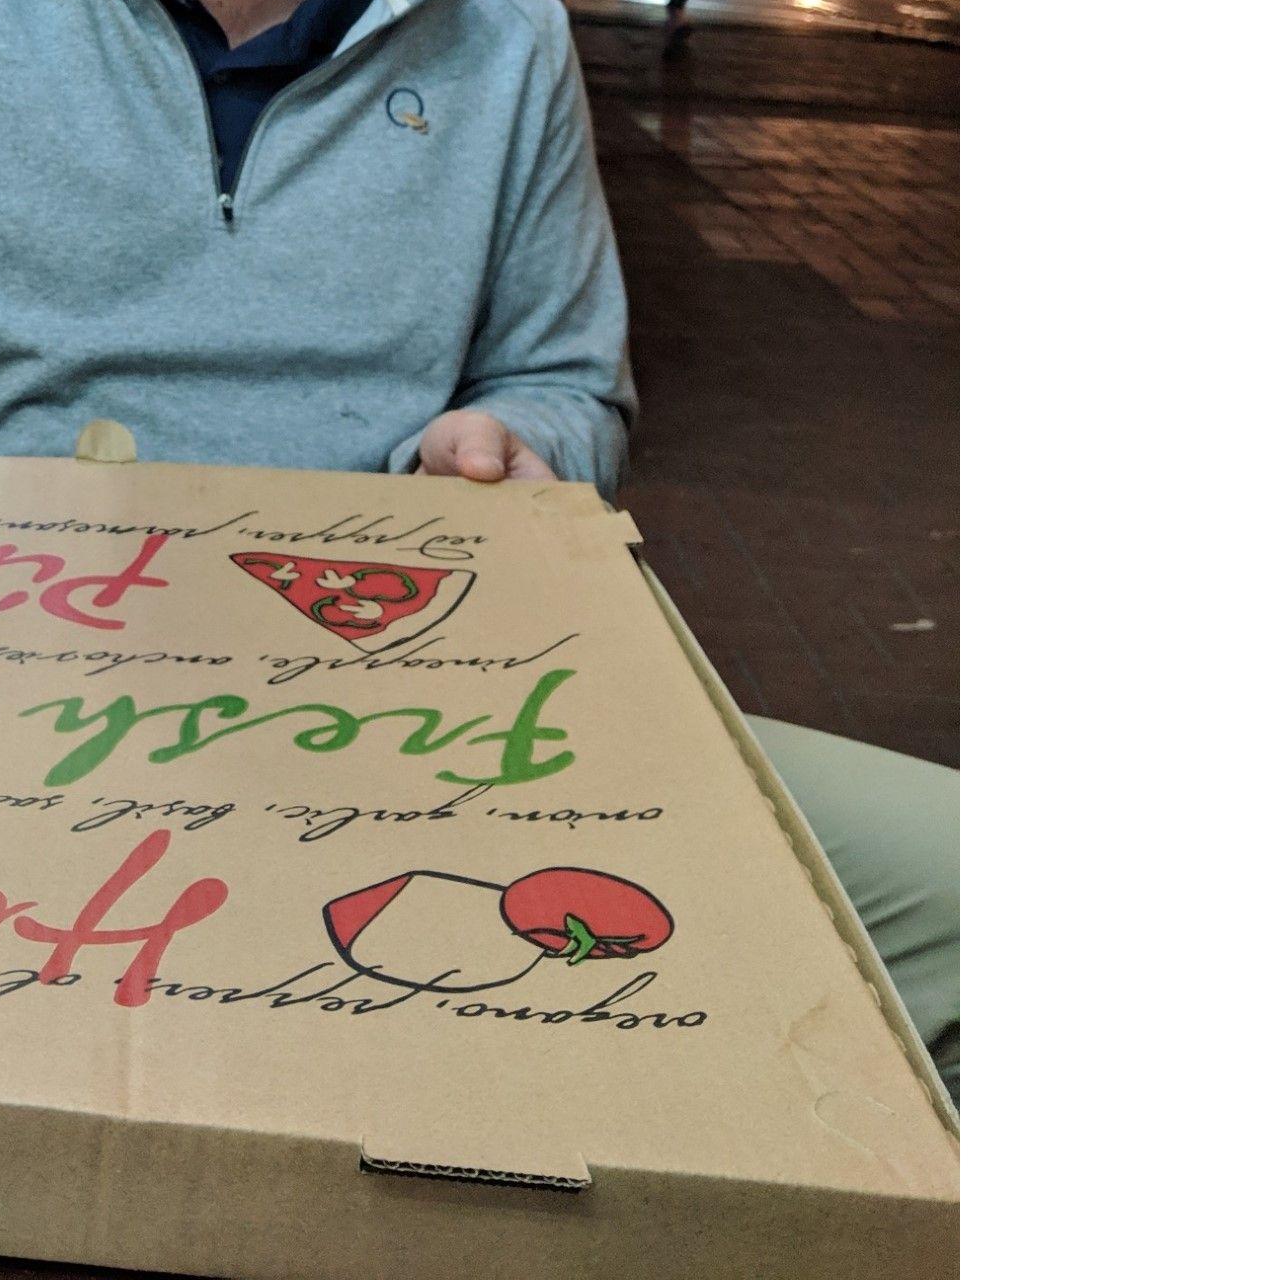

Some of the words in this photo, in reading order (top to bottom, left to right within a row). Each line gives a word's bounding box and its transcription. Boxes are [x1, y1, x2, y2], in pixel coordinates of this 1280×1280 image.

[239, 511, 445, 545] pepper,
[262, 634, 580, 684] pineapple,
[18, 668, 577, 788] Fresh
[71, 794, 237, 833] basil,
[266, 783, 495, 842] garlic,
[487, 806, 665, 830] onion,
[436, 971, 708, 1030] oregano,
